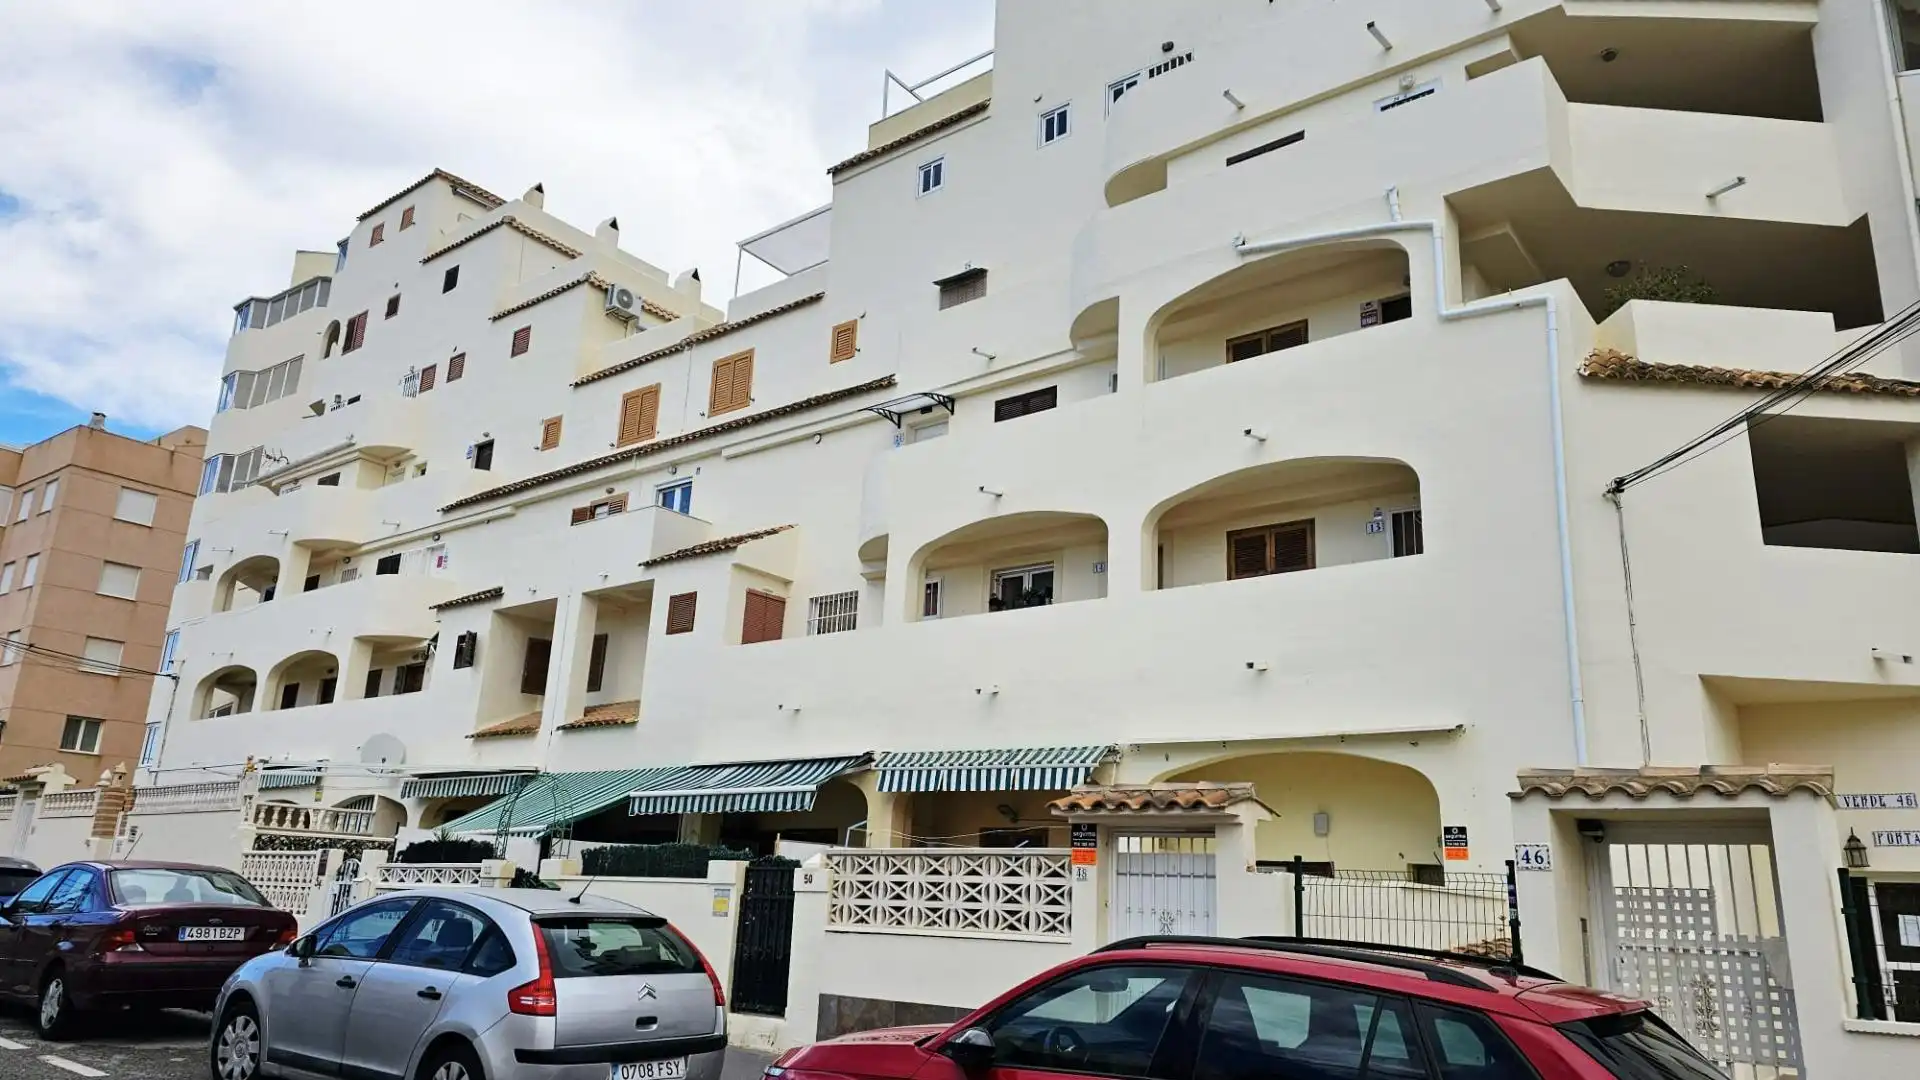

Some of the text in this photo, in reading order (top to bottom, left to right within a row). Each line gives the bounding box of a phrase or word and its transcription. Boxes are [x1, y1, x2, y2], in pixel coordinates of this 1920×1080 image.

[1369, 522, 1382, 533] 13
[1896, 794, 1913, 806] 46
[1521, 849, 1545, 865] 46
[804, 873, 813, 884] 50
[186, 927, 241, 940] 4981BZP
[621, 1060, 680, 1080] 0708 FSY
